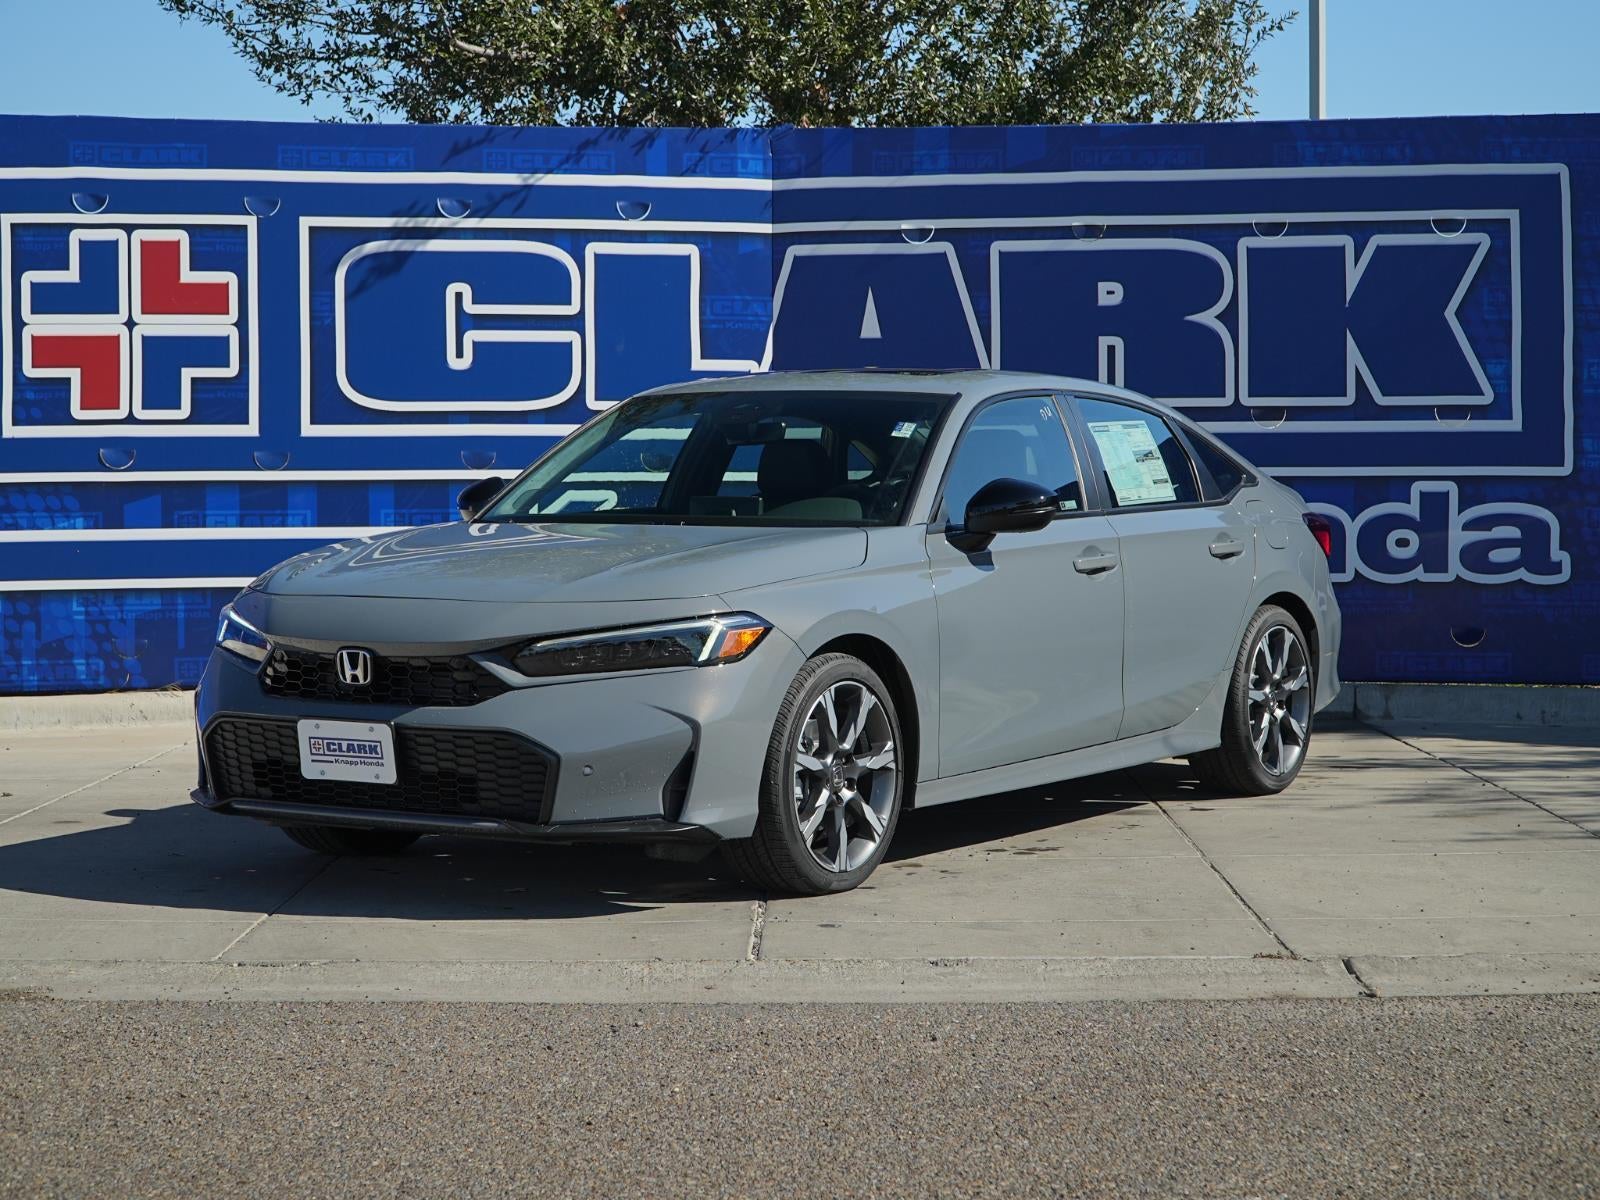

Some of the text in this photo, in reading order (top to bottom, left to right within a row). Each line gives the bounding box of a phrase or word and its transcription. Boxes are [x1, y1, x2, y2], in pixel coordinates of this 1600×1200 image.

[335, 232, 1495, 412] CLARK
[326, 741, 380, 756] CLARK
[334, 758, 385, 768] Knapp Honda
